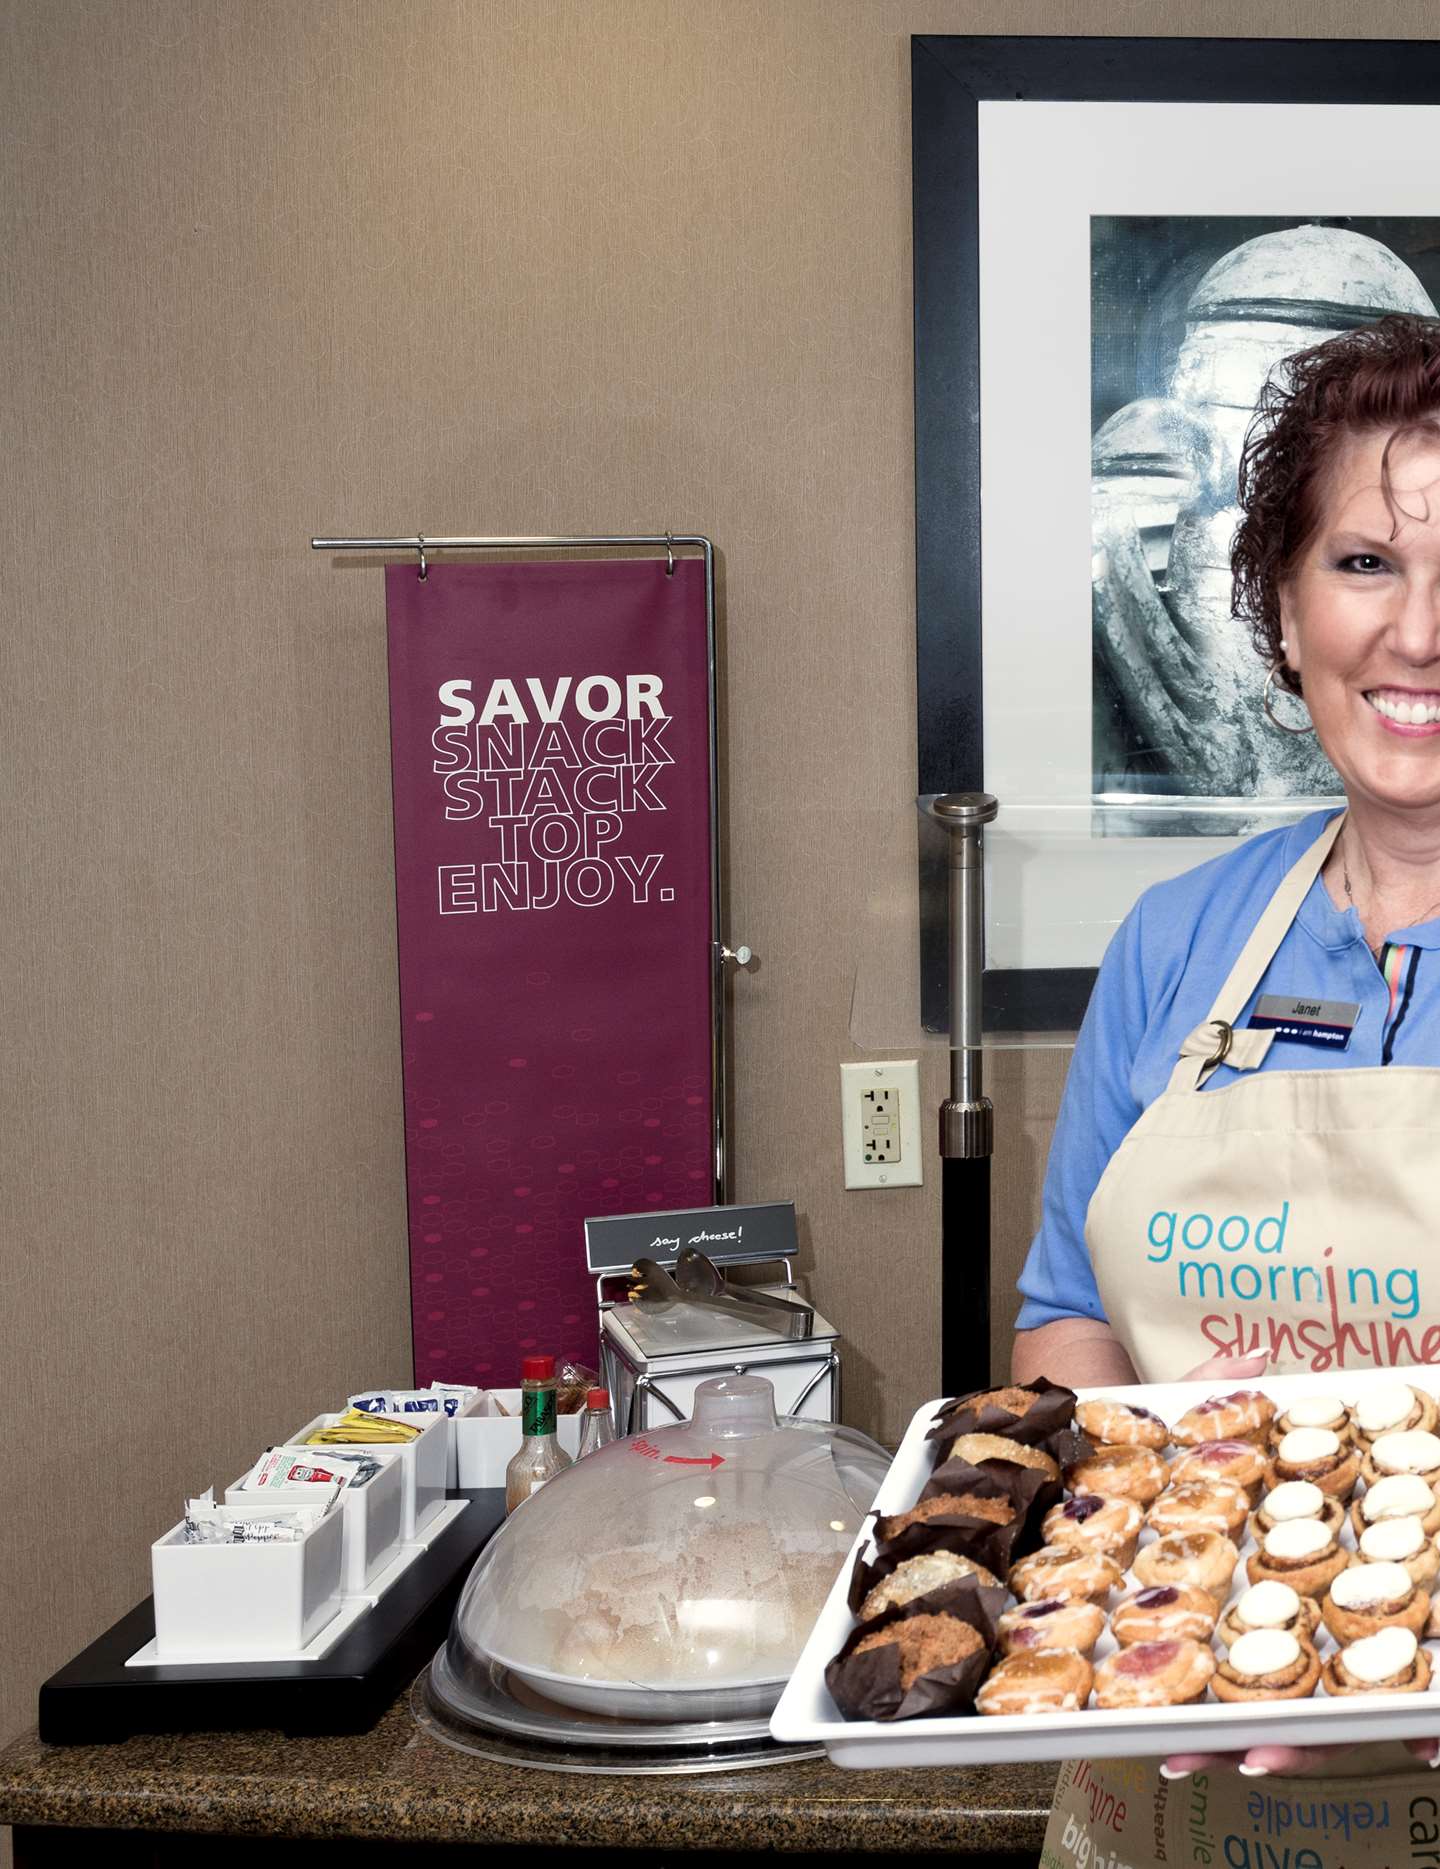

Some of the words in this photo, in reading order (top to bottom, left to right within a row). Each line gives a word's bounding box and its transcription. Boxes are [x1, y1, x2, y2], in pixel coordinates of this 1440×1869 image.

[438, 675, 666, 727] SAVOR
[432, 717, 675, 774] SNACK
[444, 763, 667, 821] STACK
[489, 812, 623, 864] TOP
[438, 854, 675, 915] ENJOY.
[1291, 1001, 1322, 1017] Janet
[1312, 1029, 1345, 1041] hampton
[650, 1236, 681, 1252] say
[1147, 1200, 1290, 1263] good
[1177, 1247, 1421, 1320] morning
[1053, 1759, 1077, 1812] inspir
[1061, 1813, 1093, 1869] big
[1153, 1774, 1169, 1863] breathe
[1189, 1773, 1216, 1865] smile
[1247, 1791, 1390, 1841] rekindle
